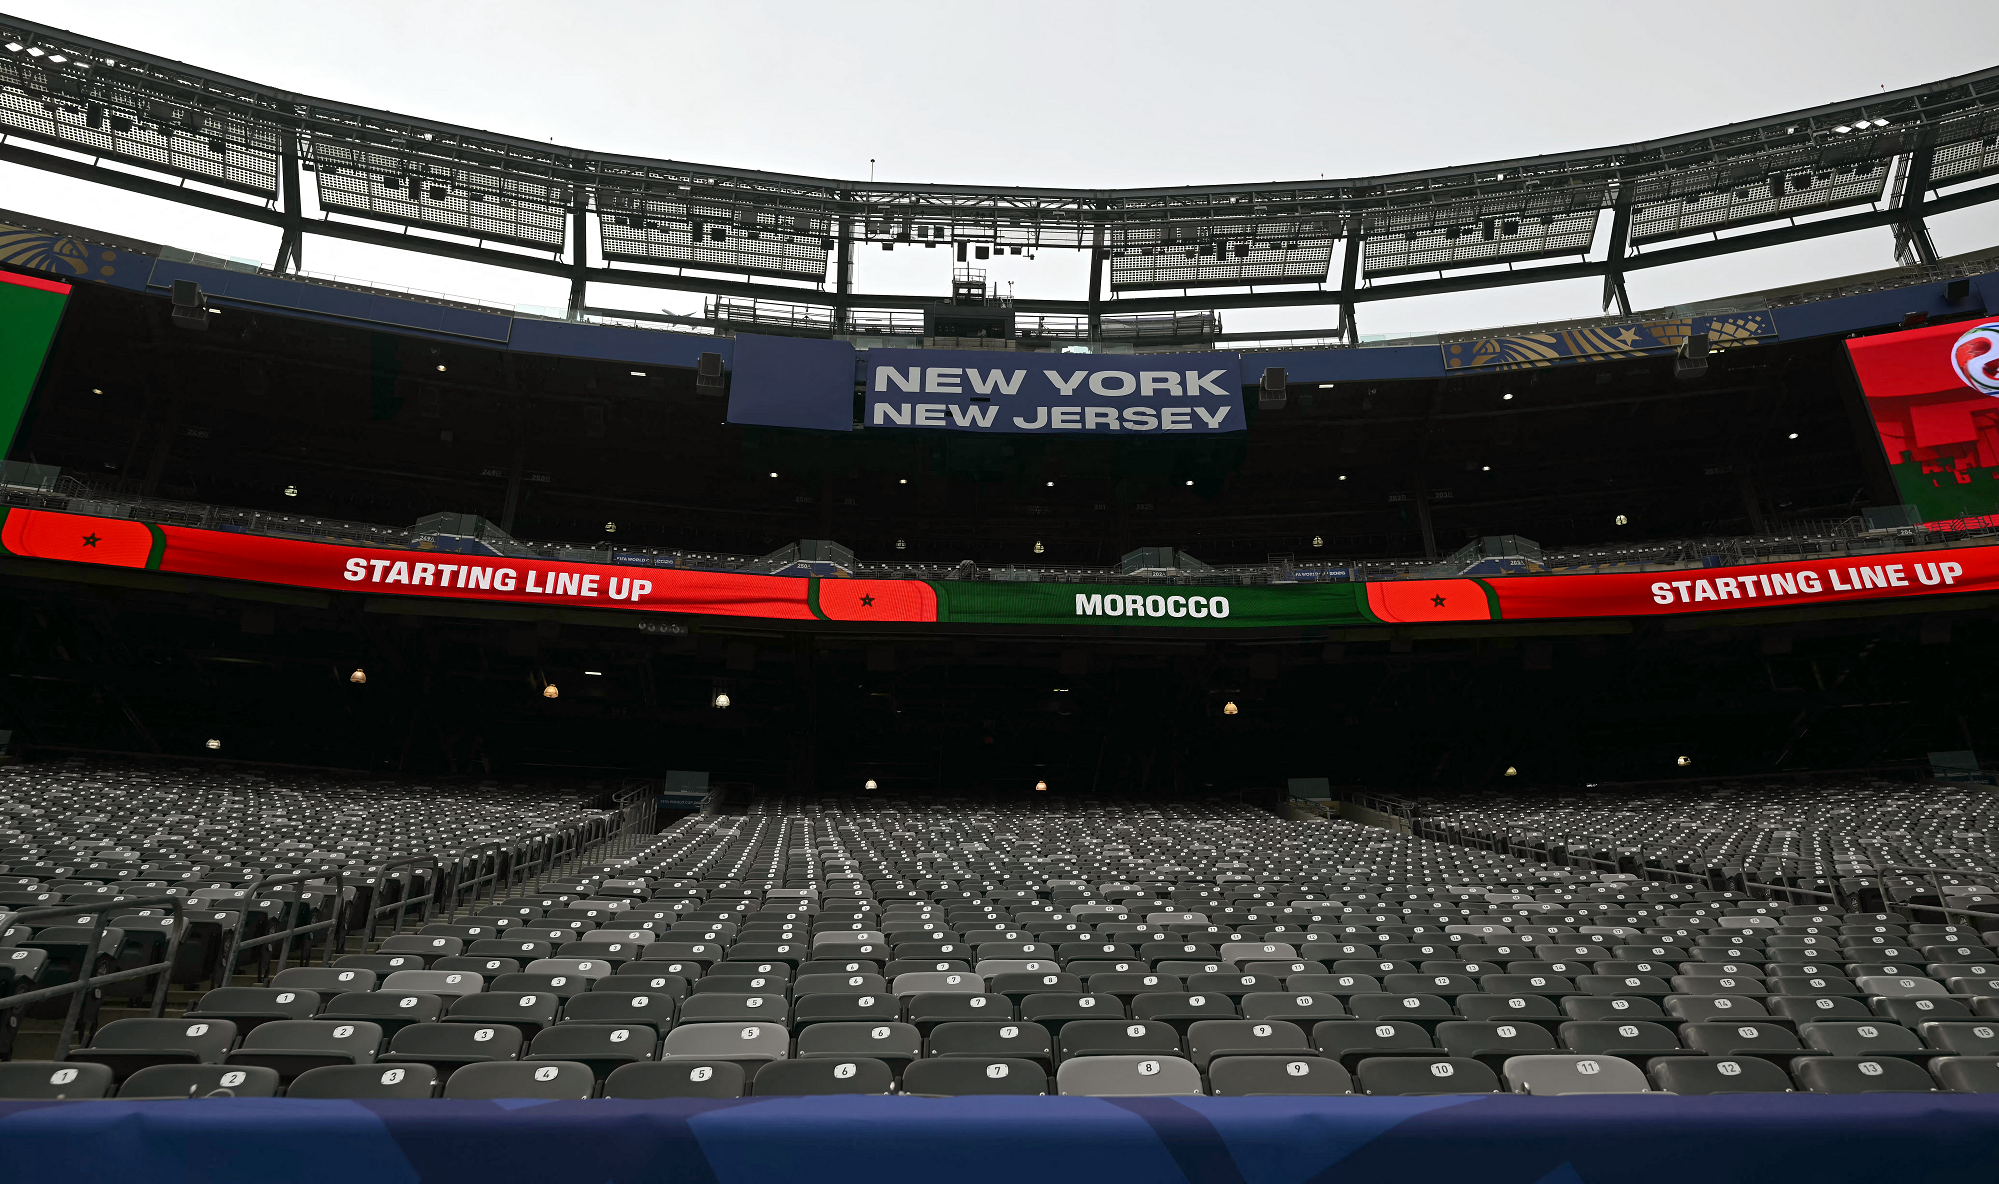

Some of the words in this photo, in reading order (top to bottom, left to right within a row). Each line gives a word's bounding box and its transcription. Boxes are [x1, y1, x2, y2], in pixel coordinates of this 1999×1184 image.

[874, 365, 1027, 396] NEW
[1043, 369, 1231, 397] YORK
[873, 402, 1000, 428] NEW
[1013, 405, 1232, 431] JERSEY
[343, 557, 517, 592] STARTING
[525, 570, 600, 597] LINE
[608, 576, 653, 602] UP
[1650, 570, 1823, 605] STARTING
[1828, 564, 1909, 591] LINE
[1913, 561, 1963, 586] UP
[1075, 593, 1230, 618] MOROCCO
[340, 1028, 347, 1036] 2
[748, 1029, 753, 1037] 5
[842, 1067, 848, 1075] 6
[995, 1067, 1000, 1075] 7
[1146, 1064, 1152, 1072] 8
[1295, 1065, 1300, 1073] 9
[1436, 1065, 1448, 1074] 10
[1582, 1063, 1594, 1072] 11
[1722, 1064, 1736, 1073] 12
[1863, 1064, 1877, 1072] 13
[62, 1072, 68, 1081] 1
[229, 1074, 237, 1083] 2
[389, 1072, 397, 1081] 3
[543, 1070, 549, 1078] 4
[699, 1070, 705, 1078] 5
